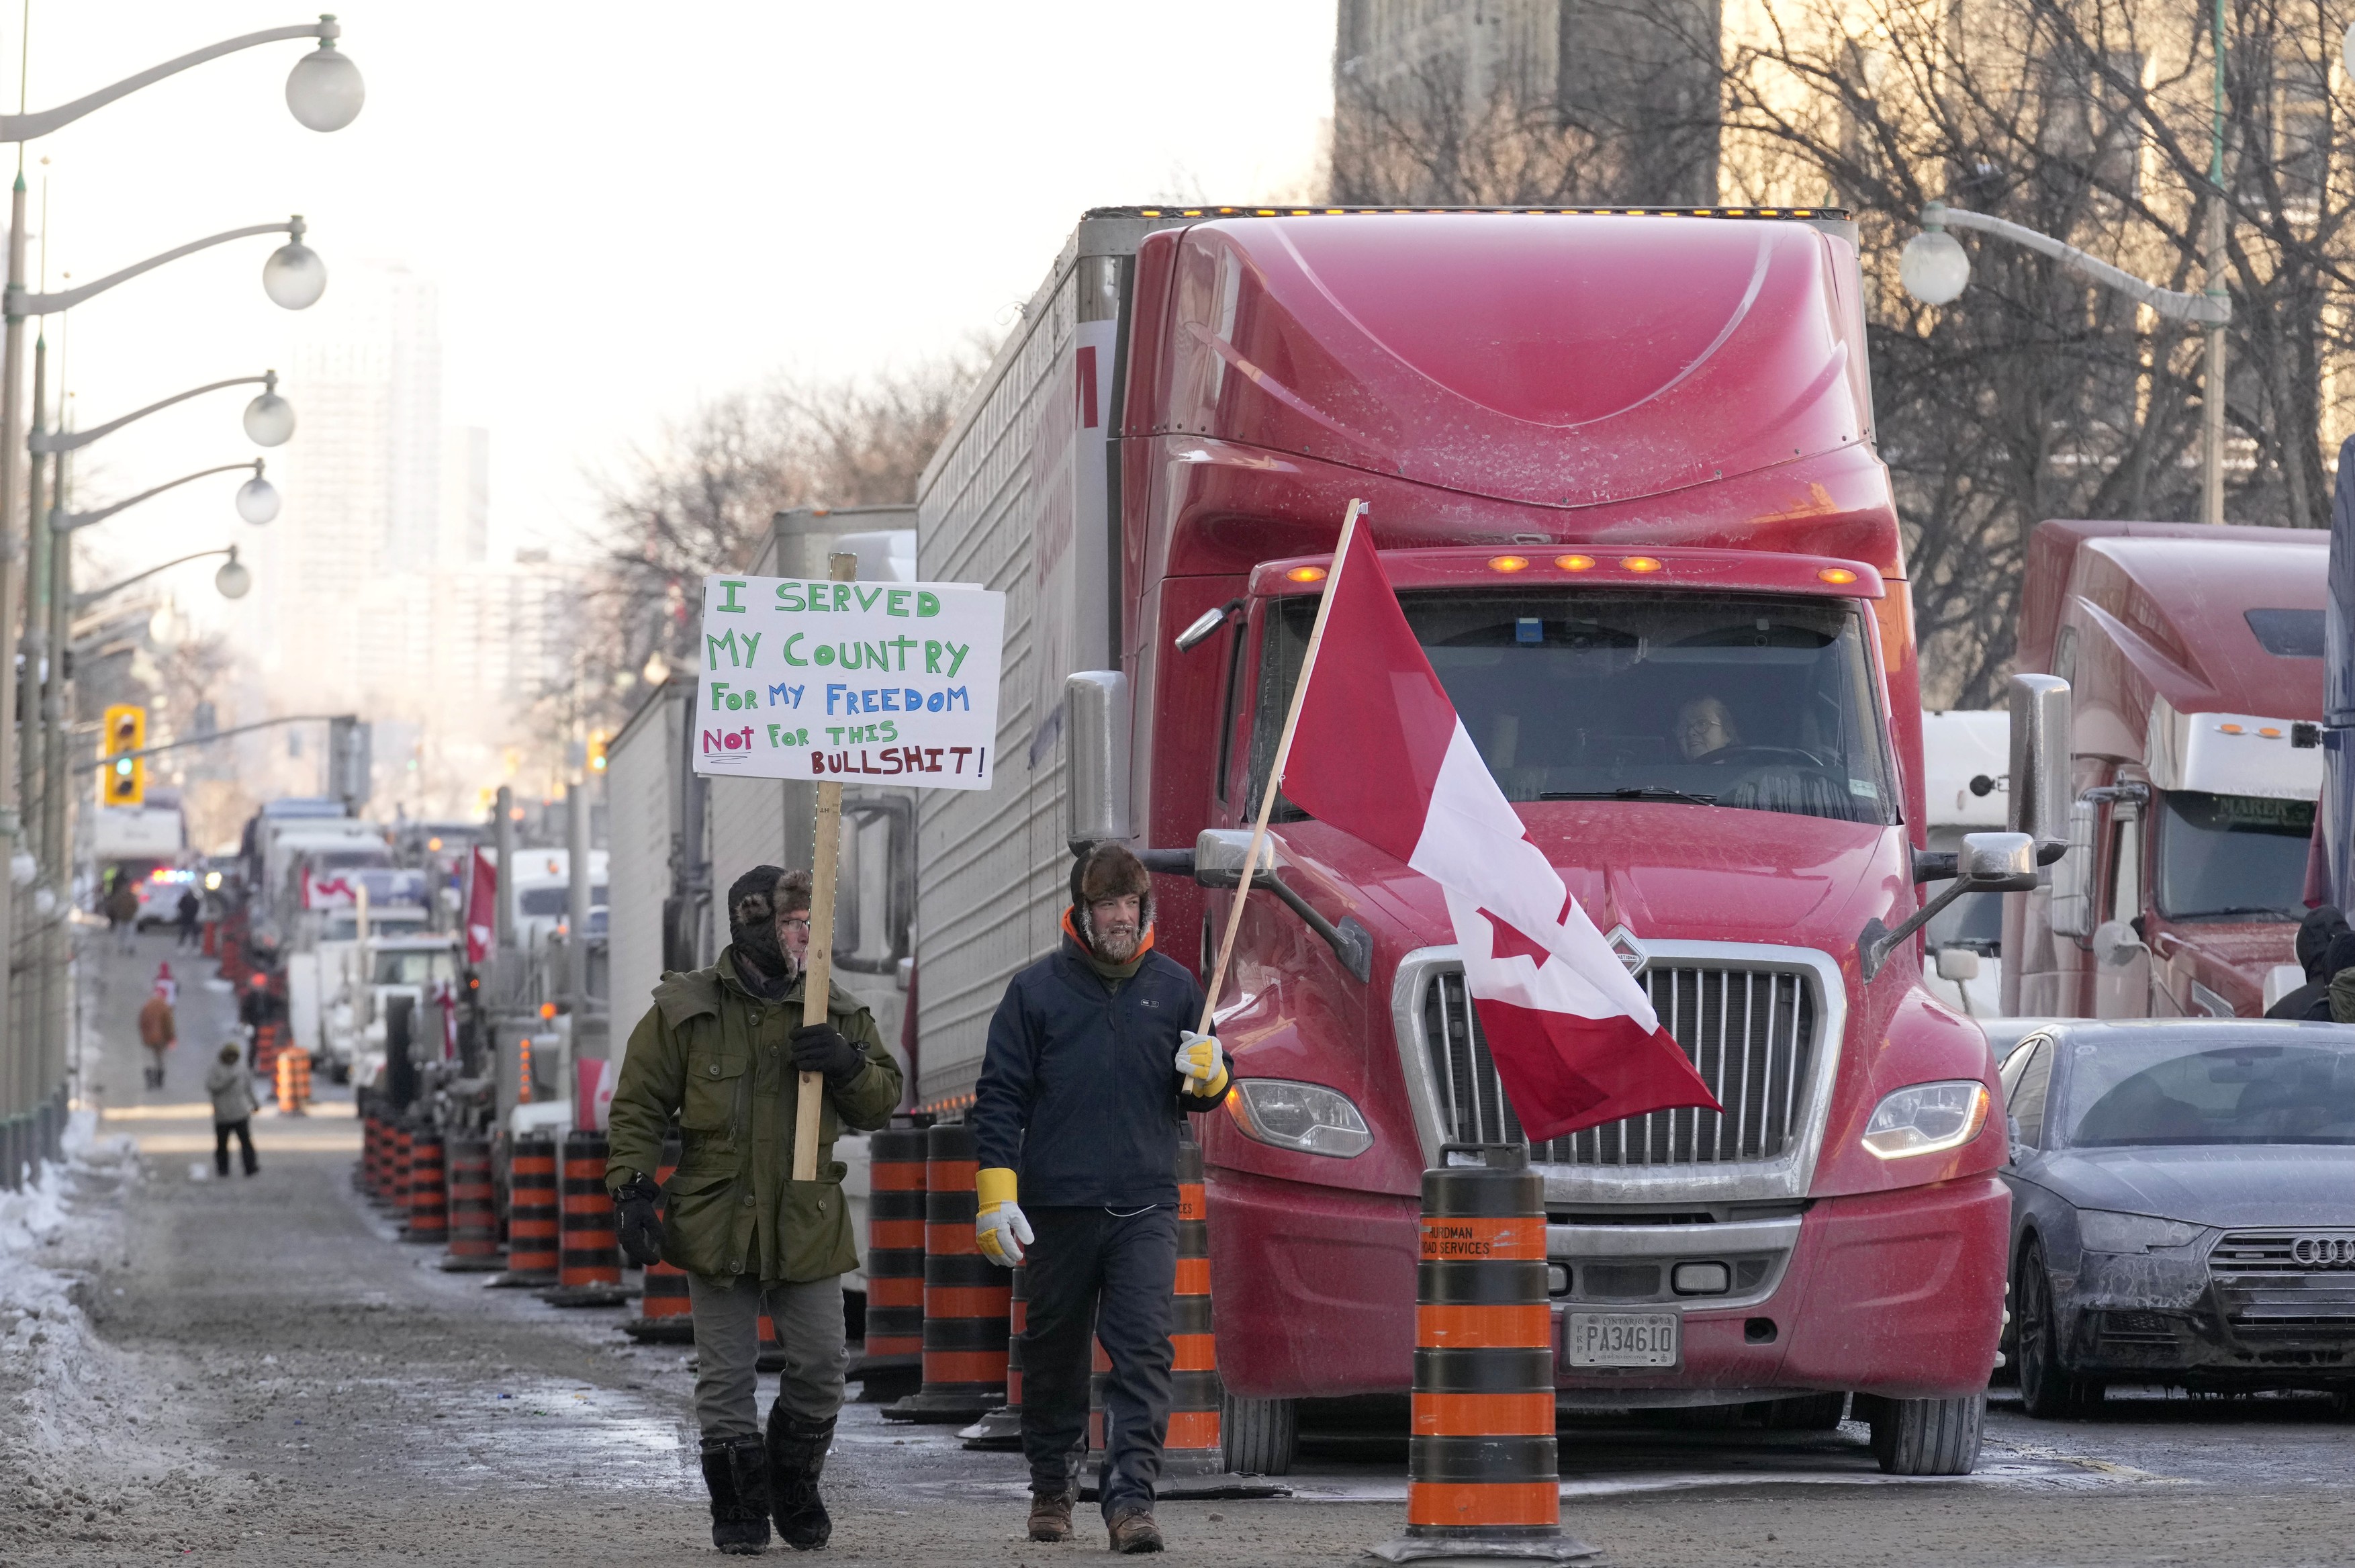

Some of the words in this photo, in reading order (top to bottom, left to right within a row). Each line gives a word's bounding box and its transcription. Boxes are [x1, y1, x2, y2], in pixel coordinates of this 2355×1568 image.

[717, 580, 747, 613] I
[775, 582, 941, 618] SERVED
[706, 628, 761, 670] MY
[783, 633, 970, 678] COUNTRY
[710, 682, 758, 710] FOR
[768, 682, 804, 709] MY
[827, 684, 970, 715] FREEDOM
[767, 724, 809, 747] FOR
[825, 721, 898, 745] THIS
[812, 746, 985, 778] BULLSHIT!
[1429, 1227, 1473, 1240] HURDMAN
[1440, 1242, 1490, 1254] SERVICES
[1603, 1317, 1645, 1326] ONTARIO
[1587, 1326, 1672, 1352] PA34610
